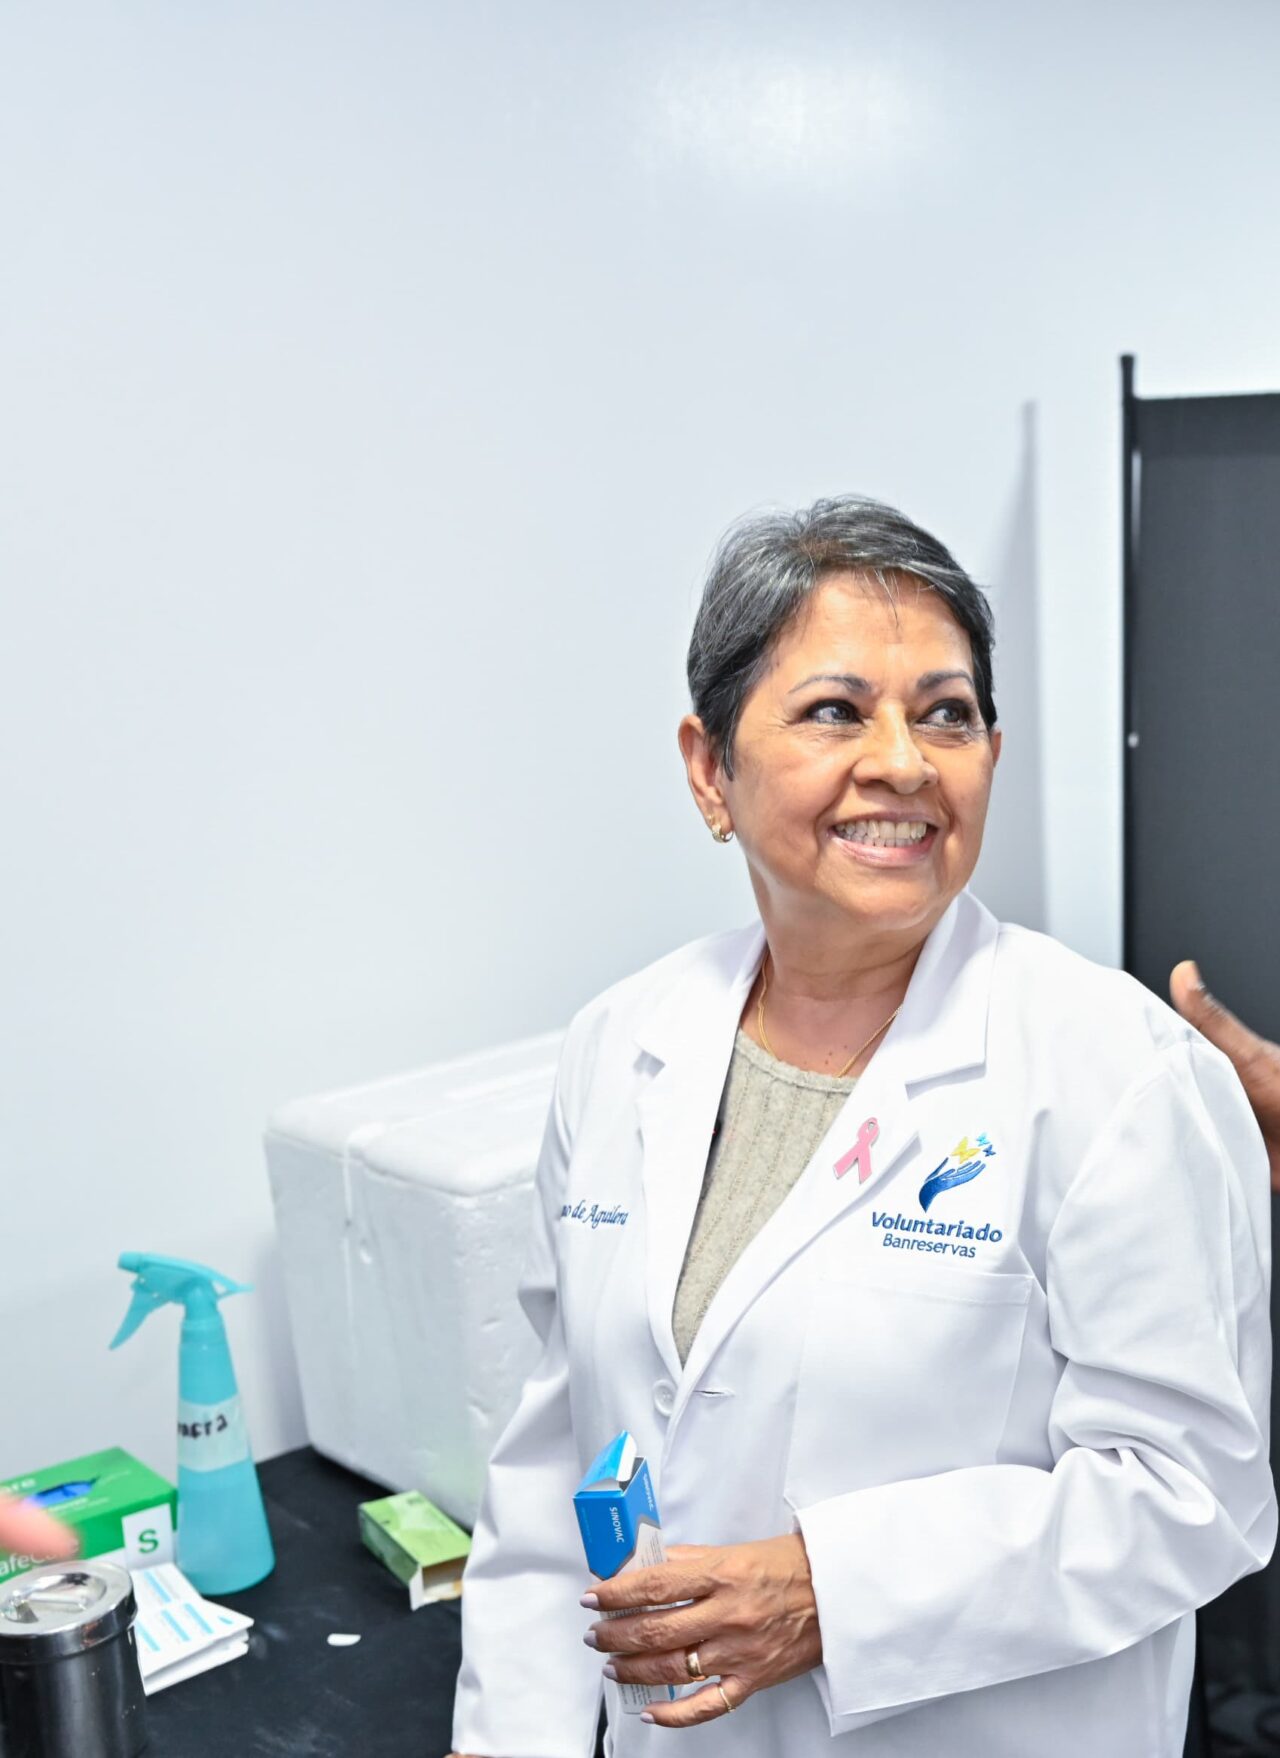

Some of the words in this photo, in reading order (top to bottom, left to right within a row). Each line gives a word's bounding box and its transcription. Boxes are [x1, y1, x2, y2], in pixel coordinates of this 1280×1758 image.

[571, 1199, 586, 1219] de
[871, 1211, 1003, 1243] Voluntariado
[882, 1233, 976, 1259] Banreservas
[609, 1506, 625, 1543] SINOVAC
[138, 1528, 160, 1554] S
